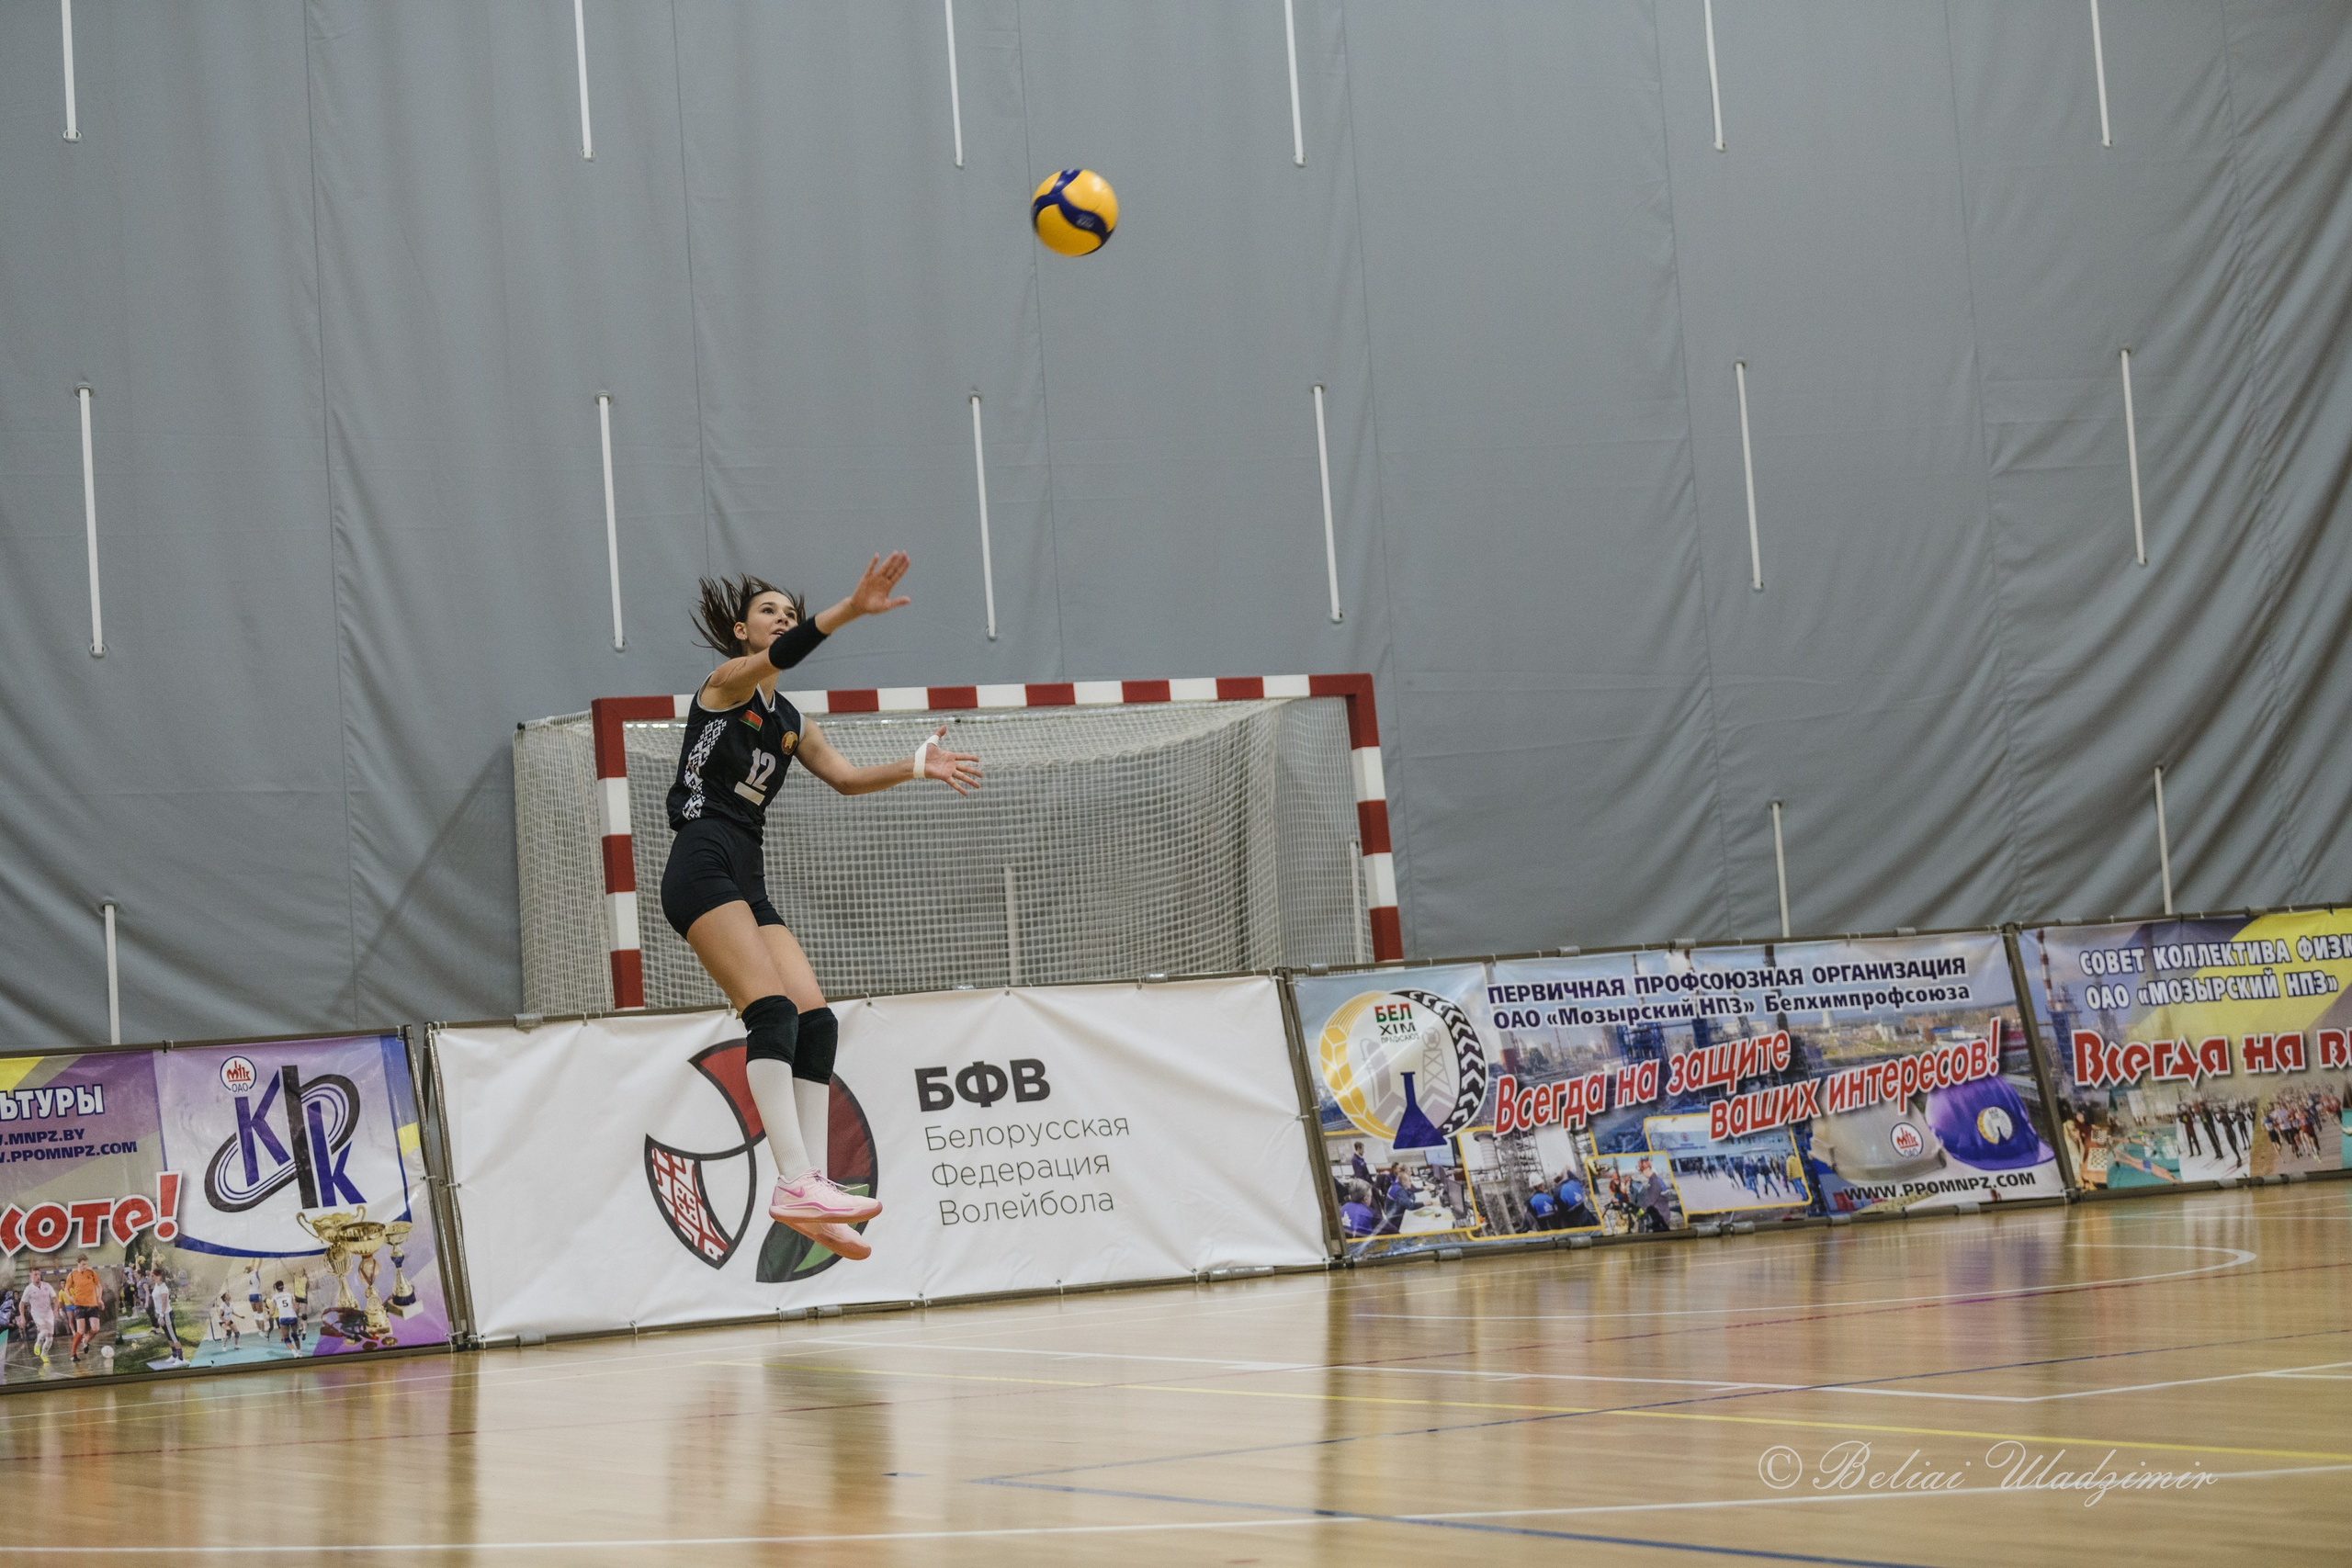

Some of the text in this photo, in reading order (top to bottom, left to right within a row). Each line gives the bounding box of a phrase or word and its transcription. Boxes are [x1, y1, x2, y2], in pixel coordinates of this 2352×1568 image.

[745, 748, 775, 792] 12
[2079, 946, 2145, 976] СОВЕТ
[2153, 939, 2291, 971] КОЛЛЕКТИВА
[1487, 956, 1967, 1005] ПЕРВИЧНАЯ ПРОФСОЮЗНАЯ ОРГАНИЗАЦИЯ
[2086, 968, 2338, 1010] ОАО «МОЗЫРСКИЙ НПЗ»
[1374, 1003, 1412, 1022] БЕЛ
[1494, 1009, 1541, 1029] ОАО
[1547, 1001, 1696, 1027] «Мозырский
[1765, 984, 1971, 1012] Белхимпрофсоюза
[914, 1058, 1050, 1112] БФВ
[1495, 1030, 1791, 1135] Всегда на защите
[1709, 1017, 2001, 1142] ваших интересов!
[925, 1117, 1129, 1151] Белорусская
[932, 1155, 1110, 1188] Федерация
[1843, 1172, 2036, 1201] WWW.PPOMNPZ.COM
[939, 1190, 1114, 1225] Волейбола
